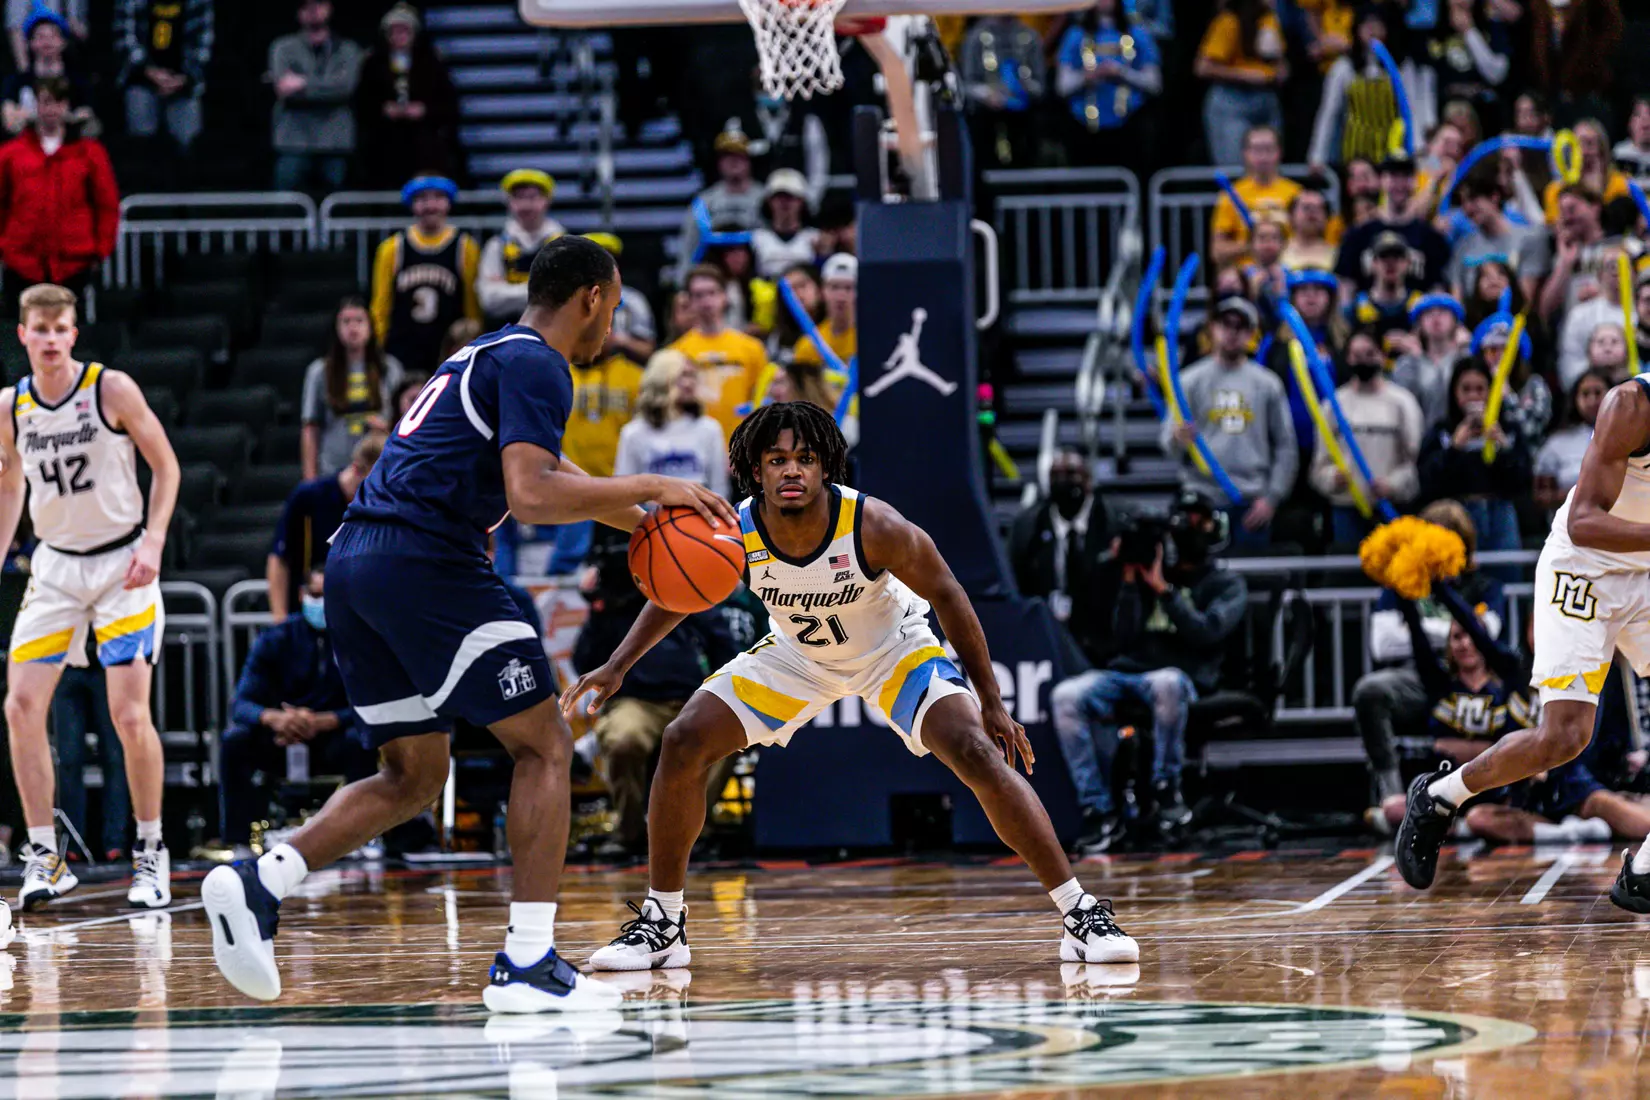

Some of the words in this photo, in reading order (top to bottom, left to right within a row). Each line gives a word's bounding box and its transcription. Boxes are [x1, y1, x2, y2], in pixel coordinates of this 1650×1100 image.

[39, 453, 94, 497] 42
[833, 573, 856, 582] EAST
[1550, 570, 1598, 622] MU
[758, 583, 865, 612] Marquette
[789, 613, 850, 648] 21
[1455, 694, 1493, 735] MU
